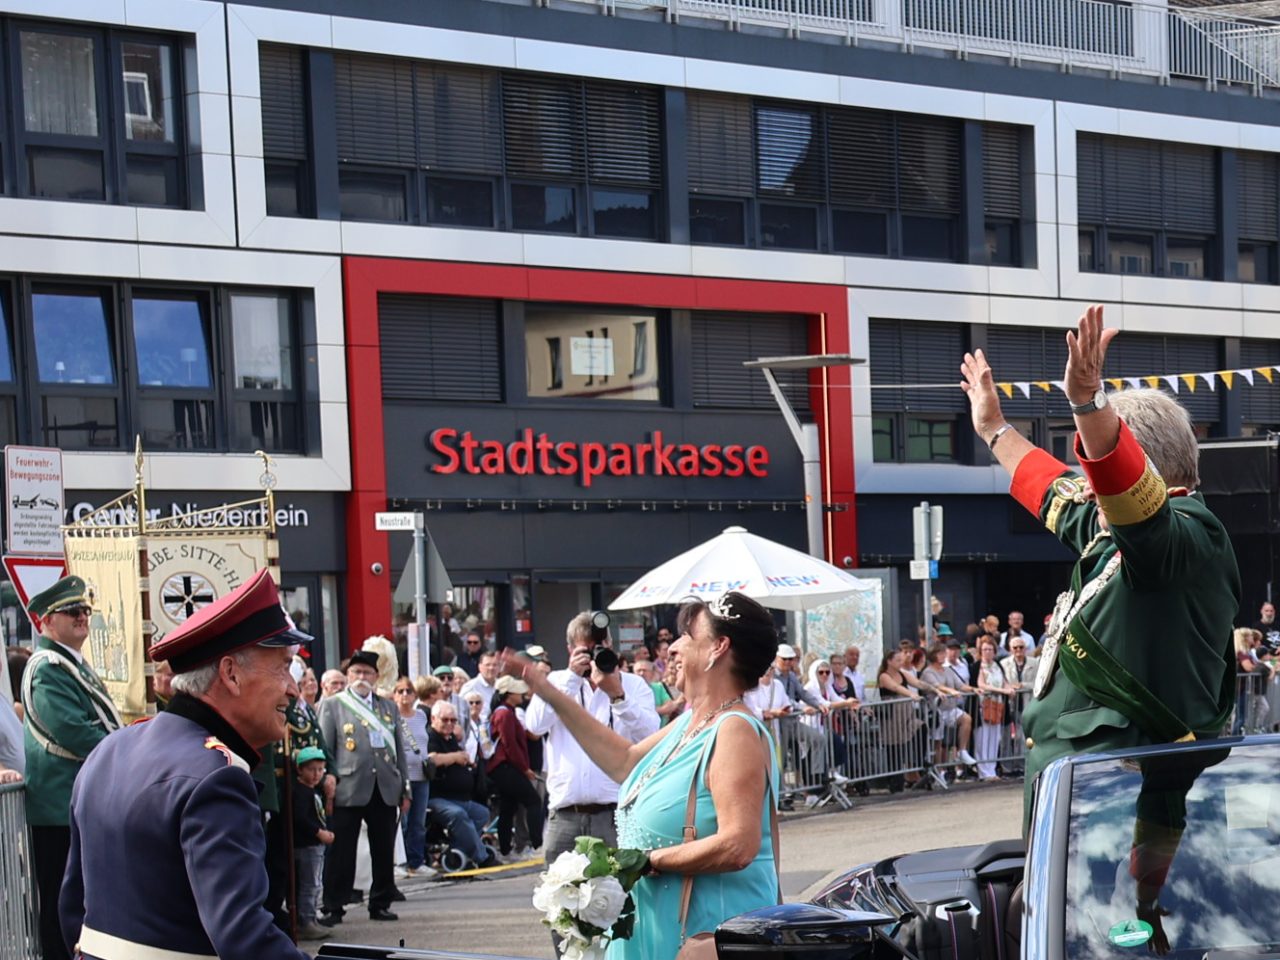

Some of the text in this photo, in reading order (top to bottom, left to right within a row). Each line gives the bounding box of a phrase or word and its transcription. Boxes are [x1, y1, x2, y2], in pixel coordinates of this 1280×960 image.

[16, 456, 53, 468] Feuerwehr-
[429, 427, 770, 487] Stadtsparkasse
[10, 470, 60, 482] Bewegungszone
[171, 502, 309, 527] Niederrhein
[148, 544, 226, 572] UBE SITTE
[690, 580, 750, 593] NEW
[766, 575, 820, 587] NEW
